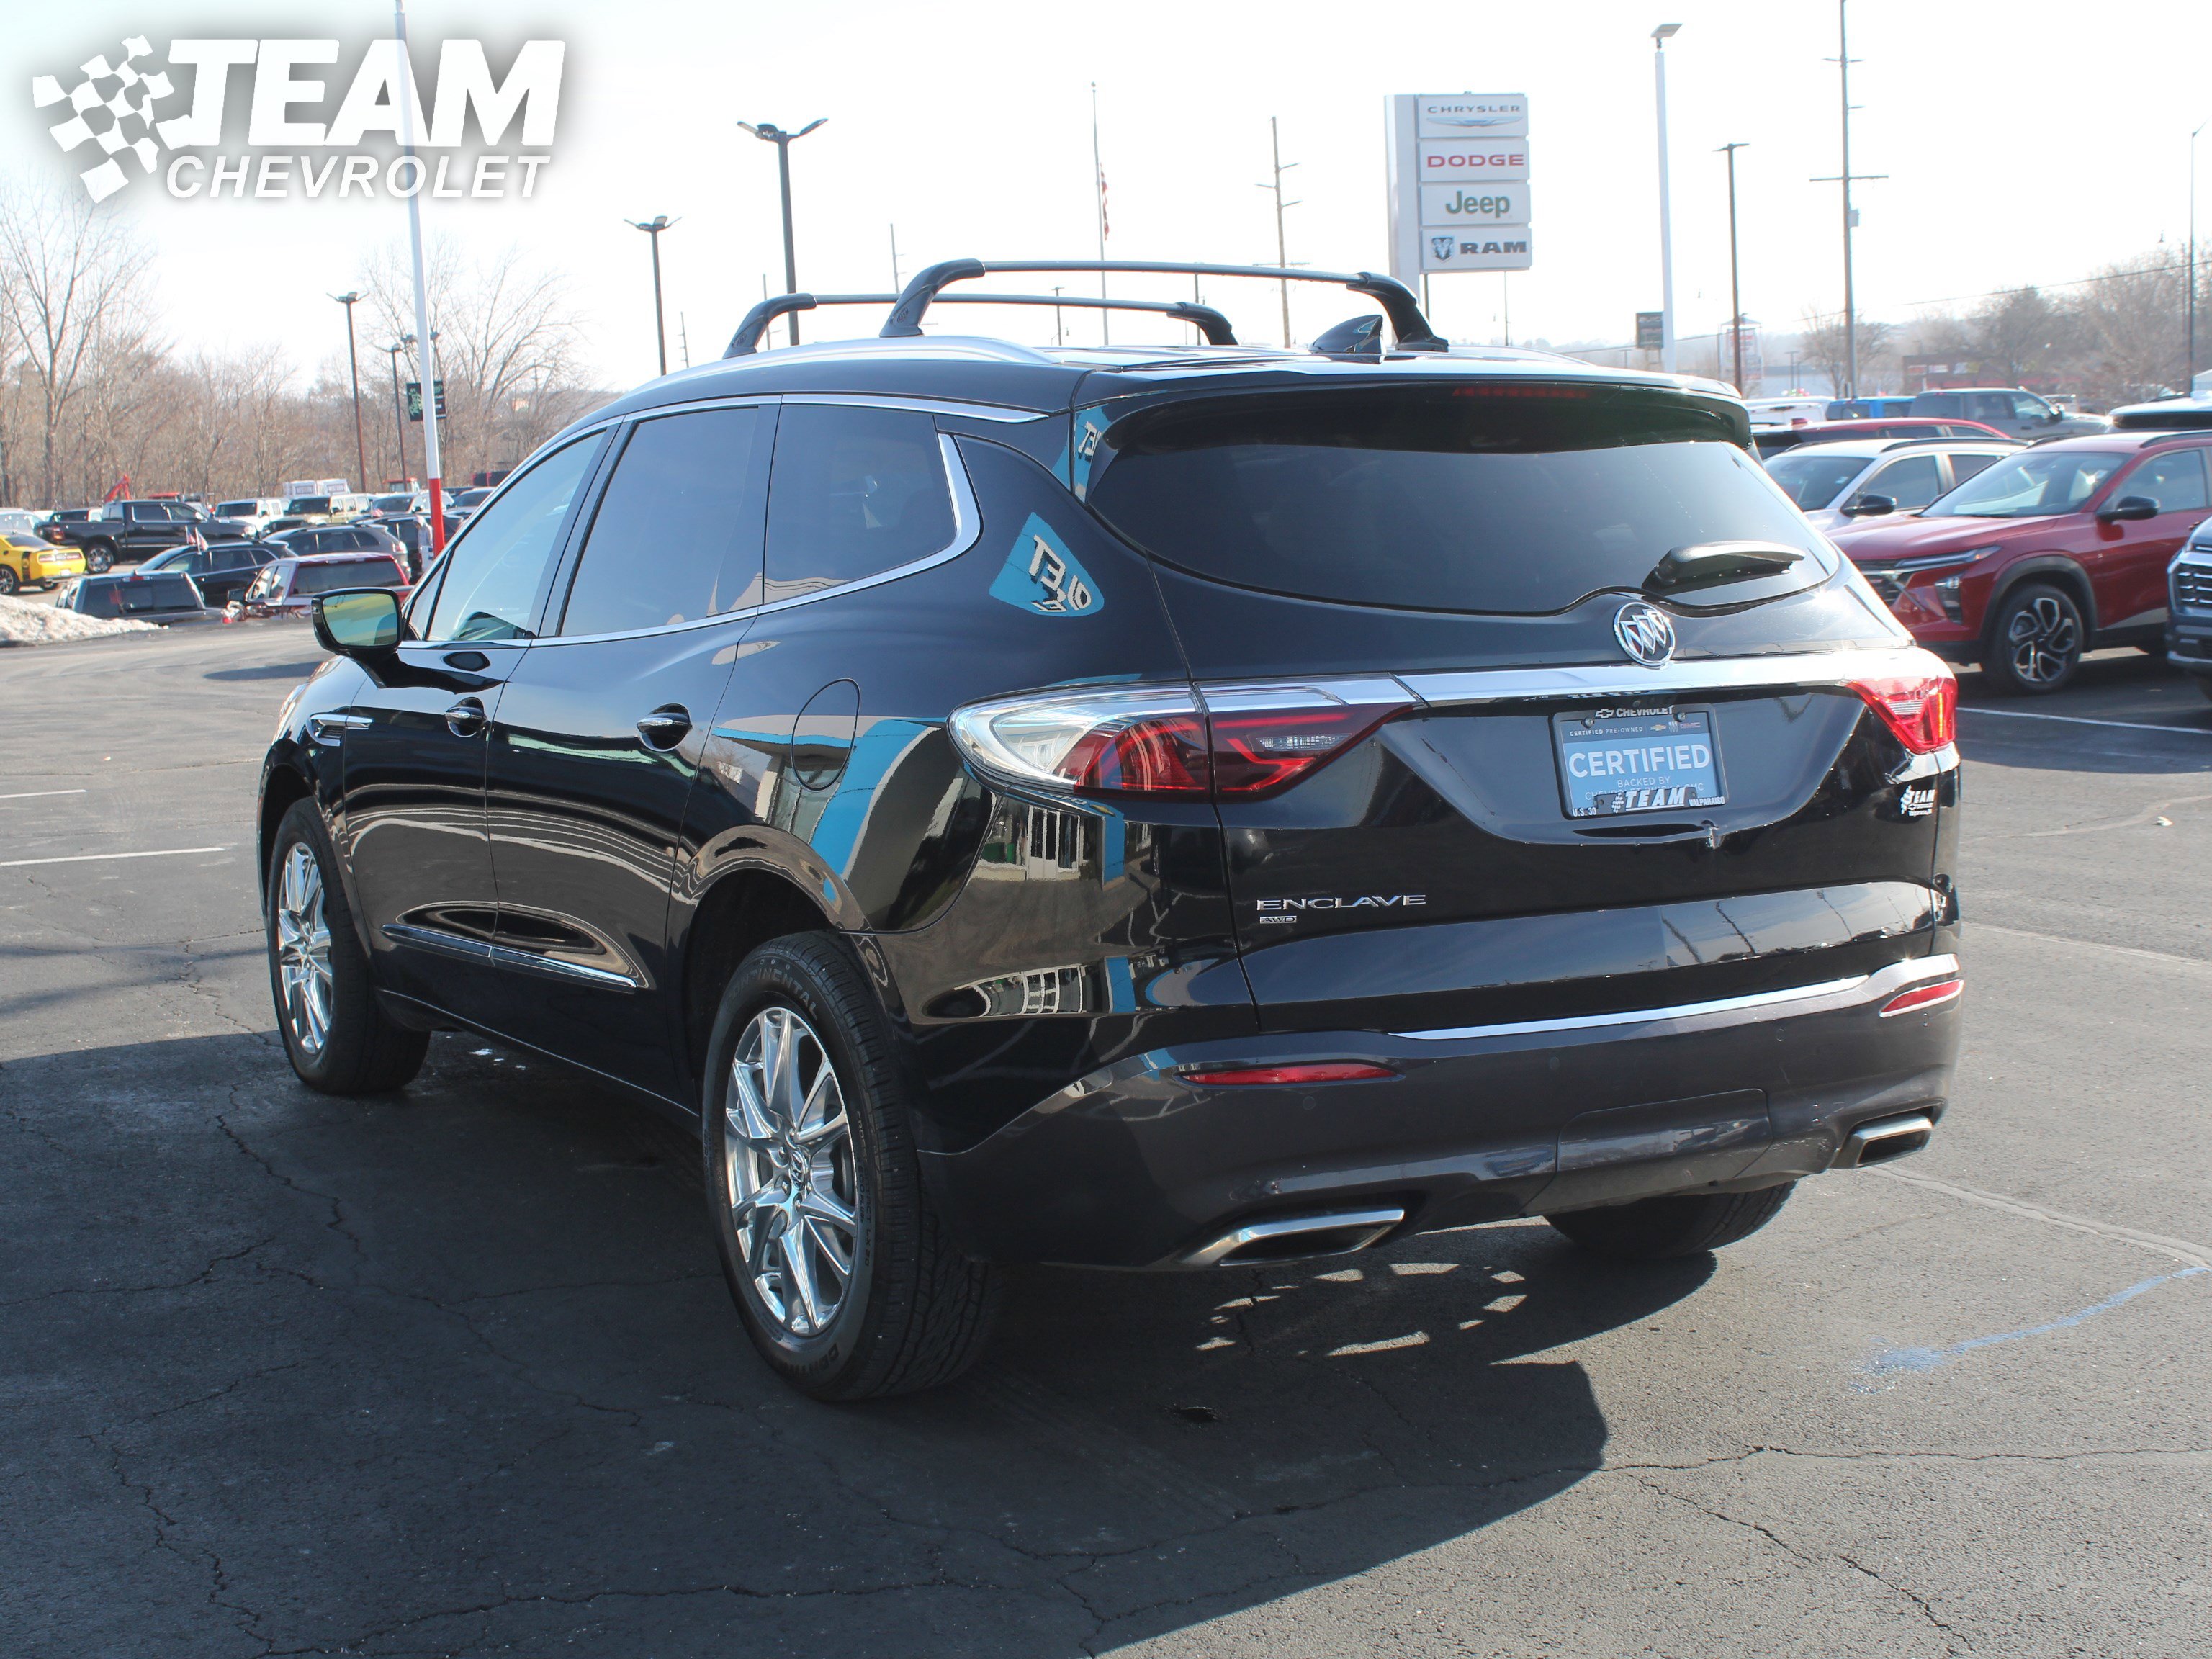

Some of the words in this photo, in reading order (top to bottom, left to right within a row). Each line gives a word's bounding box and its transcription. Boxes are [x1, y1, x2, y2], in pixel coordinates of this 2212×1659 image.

[1427, 105, 1521, 114] CHRYSLER
[1427, 154, 1524, 168] DODGE
[1445, 190, 1511, 219] Jeep
[1460, 241, 1527, 255] RAM
[1616, 705, 1674, 717] CHEVROLET
[1568, 744, 1710, 778] CERTIFIED
[1617, 778, 1655, 788] BACKED
[1625, 787, 1685, 808] TEAM
[1689, 796, 1726, 807] VALPARAISO
[1588, 807, 1597, 816] 30
[1256, 894, 1426, 910] ENCLAVE
